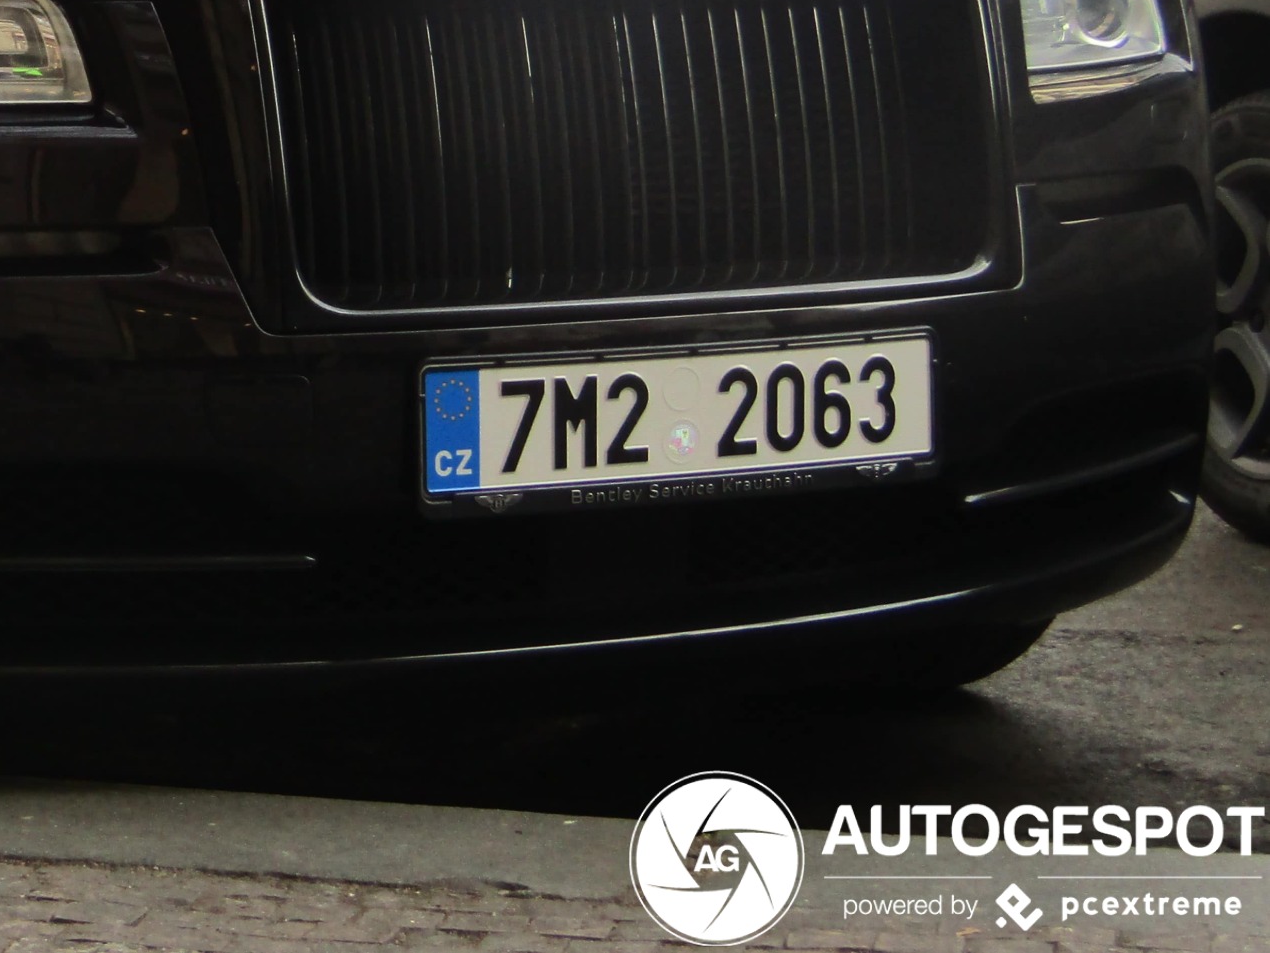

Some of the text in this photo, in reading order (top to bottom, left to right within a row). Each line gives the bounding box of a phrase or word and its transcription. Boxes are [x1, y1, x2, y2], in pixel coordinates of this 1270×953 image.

[499, 354, 897, 474] 7M2 2063
[434, 449, 473, 478] CZ
[570, 486, 643, 505] Bentley
[649, 481, 715, 499] Service
